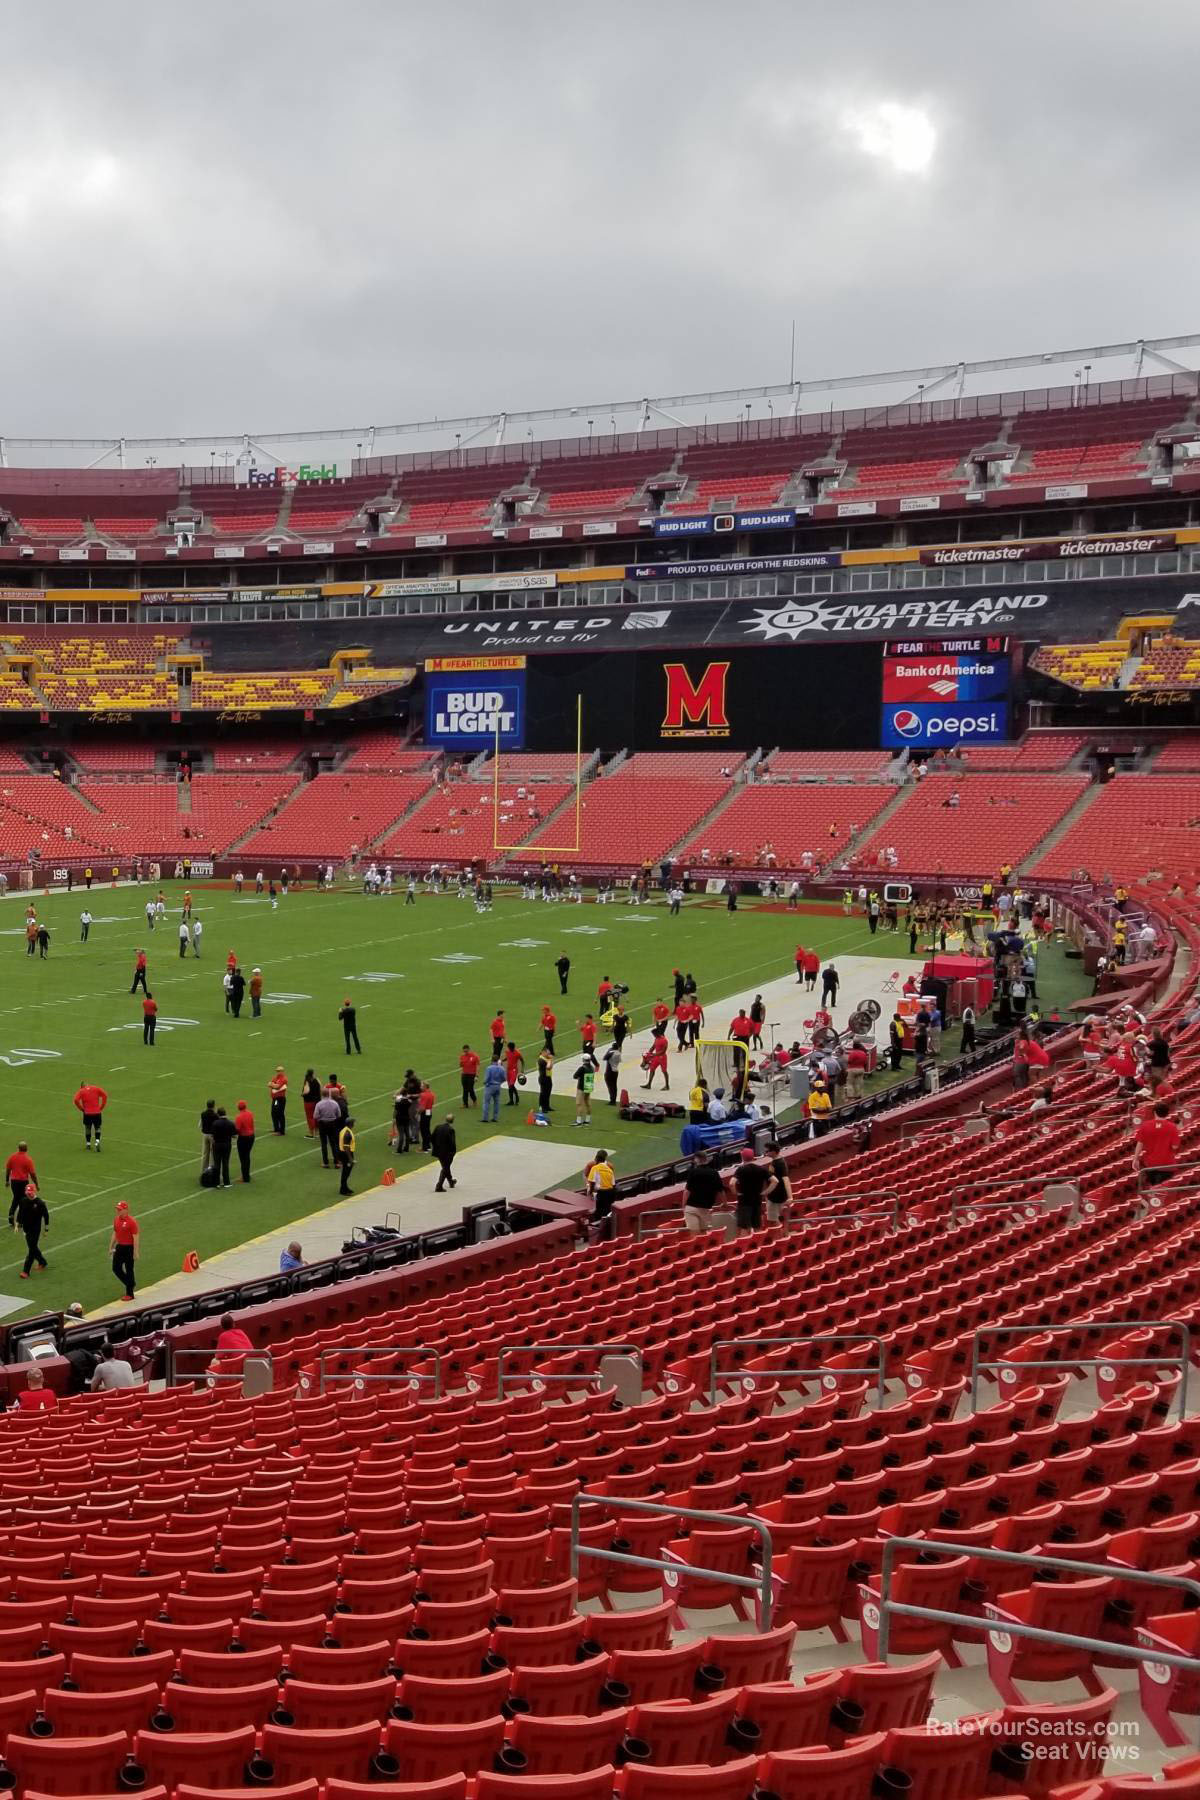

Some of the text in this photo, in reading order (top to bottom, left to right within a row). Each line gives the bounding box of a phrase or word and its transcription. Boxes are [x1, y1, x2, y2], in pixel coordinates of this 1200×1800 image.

[249, 463, 337, 483] FedExField
[660, 521, 707, 531] BUD LIGHT
[741, 515, 790, 526] BUD LIGHT
[934, 539, 1156, 564] ticketmaster ticketmaster
[668, 566, 697, 575] PROUD
[698, 565, 709, 573] TO
[710, 562, 745, 572] DELIVER
[747, 561, 763, 570] FOR
[764, 560, 781, 569] THE
[782, 557, 828, 567] REDSKINS.
[531, 577, 548, 586] sas
[841, 594, 1048, 617] MARYLAND
[444, 618, 612, 633] UNITED
[832, 610, 1004, 631] LOTTERY
[482, 633, 599, 646] Proud to fly
[896, 663, 994, 677] Bank of America
[447, 692, 504, 713] BUD
[661, 662, 730, 727] M
[436, 712, 515, 732] LIGHT
[927, 713, 996, 737] pepsi
